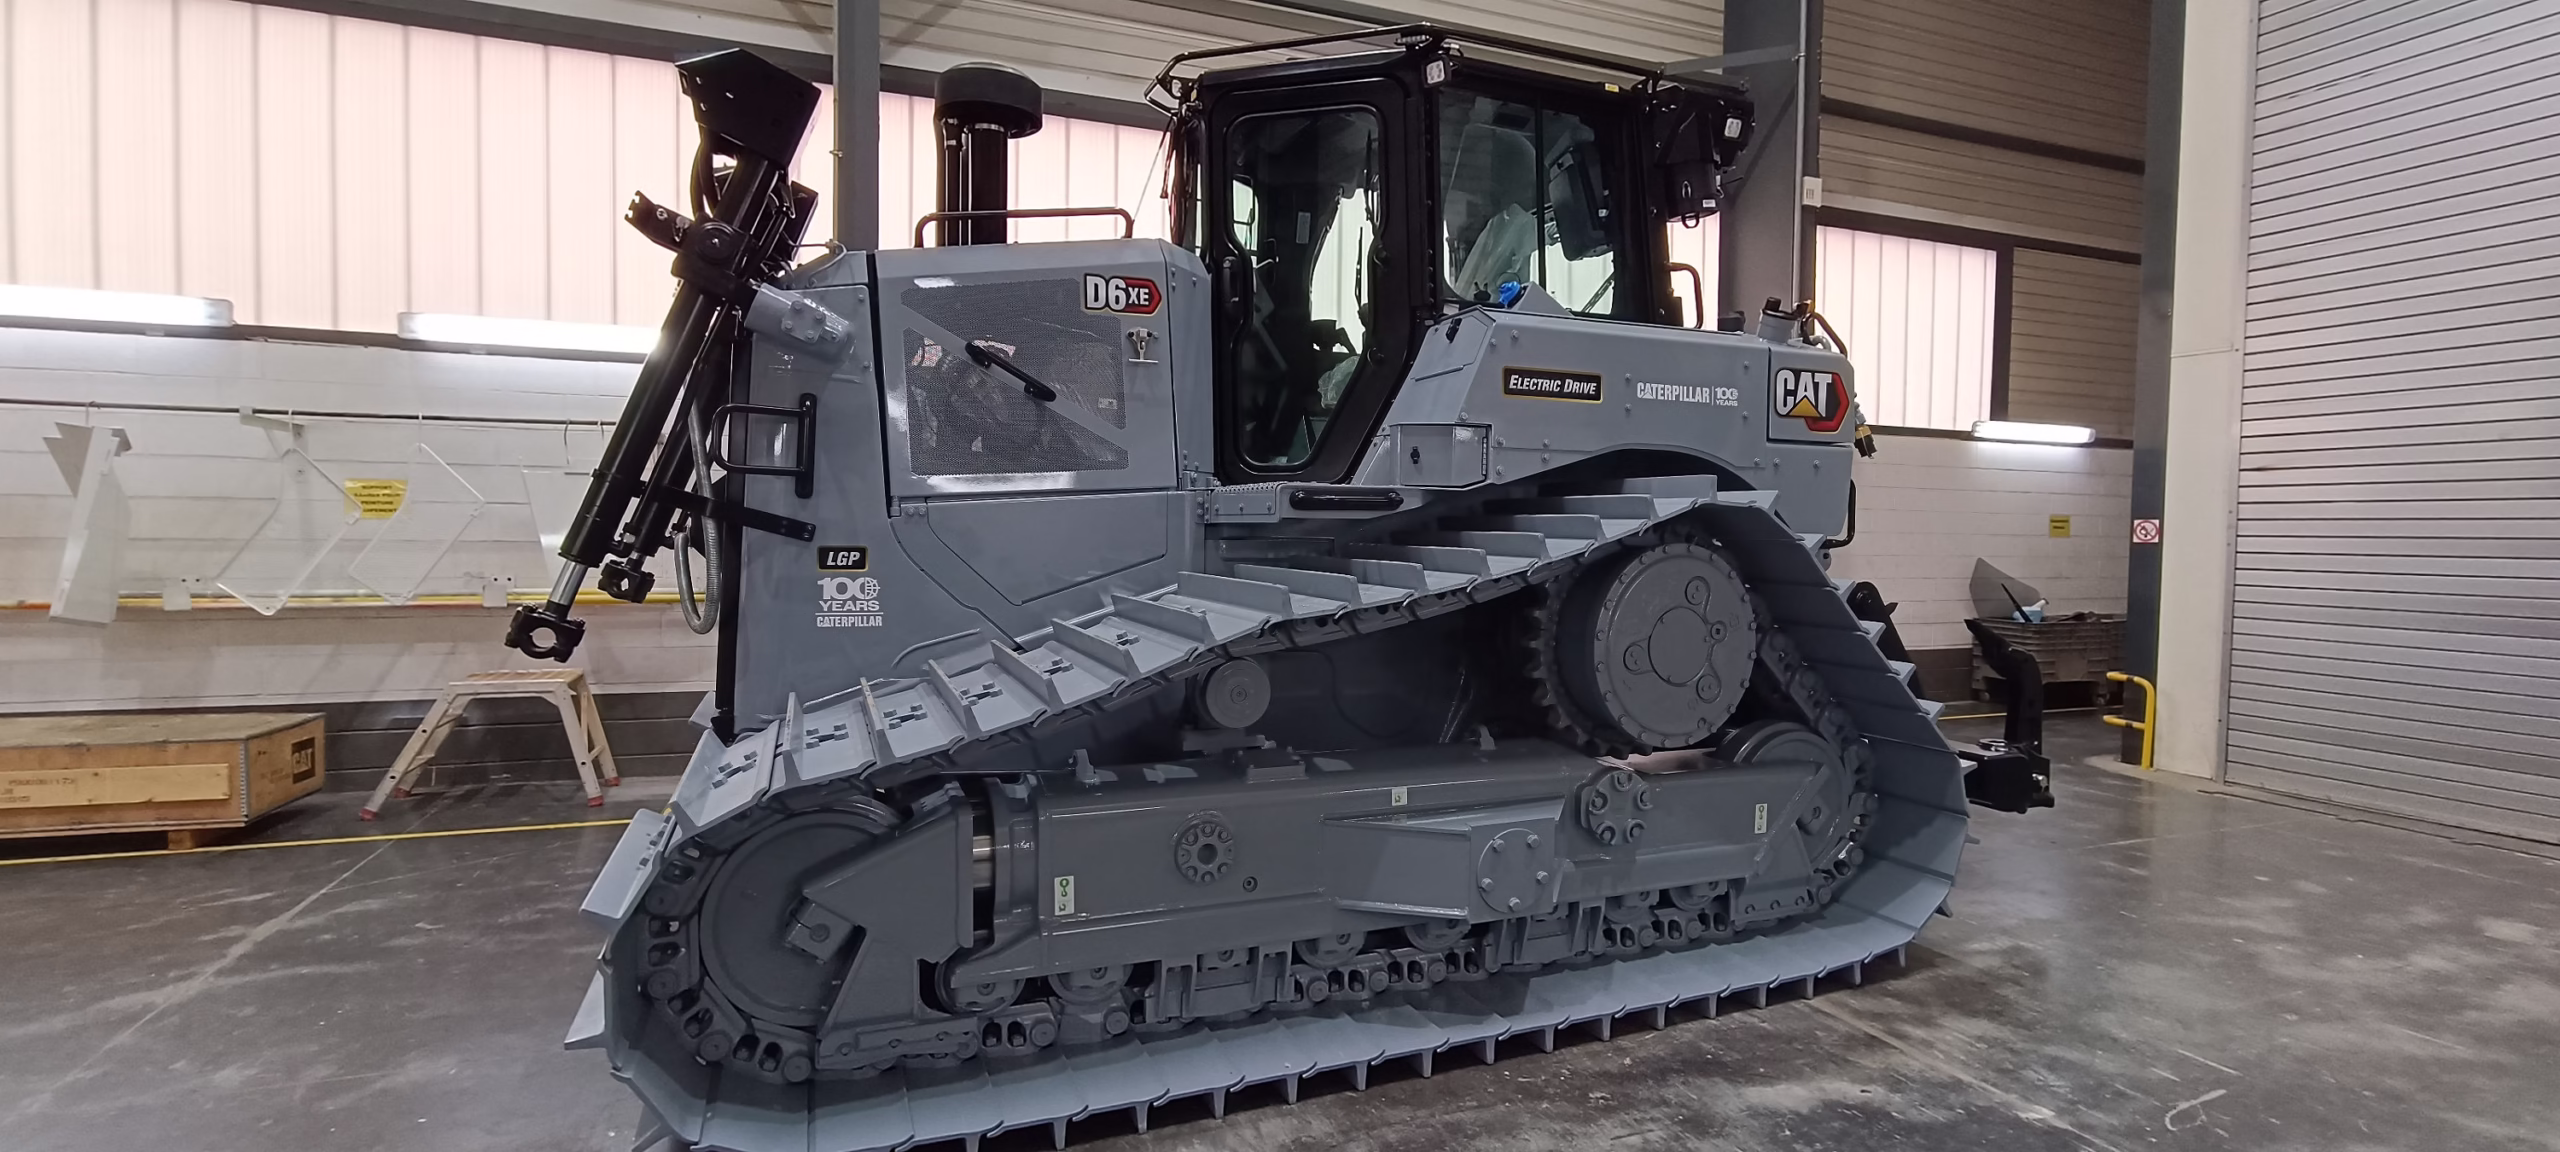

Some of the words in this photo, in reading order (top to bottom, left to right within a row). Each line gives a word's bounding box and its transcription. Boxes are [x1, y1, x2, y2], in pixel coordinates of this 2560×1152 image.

[1637, 381, 1710, 403] CATERPILLAR
[1776, 369, 1833, 417] CAT
[1716, 399, 1738, 407] YEARS
[826, 551, 861, 566] LGP
[817, 577, 881, 600] 100
[818, 600, 880, 611] YEARS
[816, 615, 883, 628] CATERPILLAR
[293, 748, 313, 774] CAT
